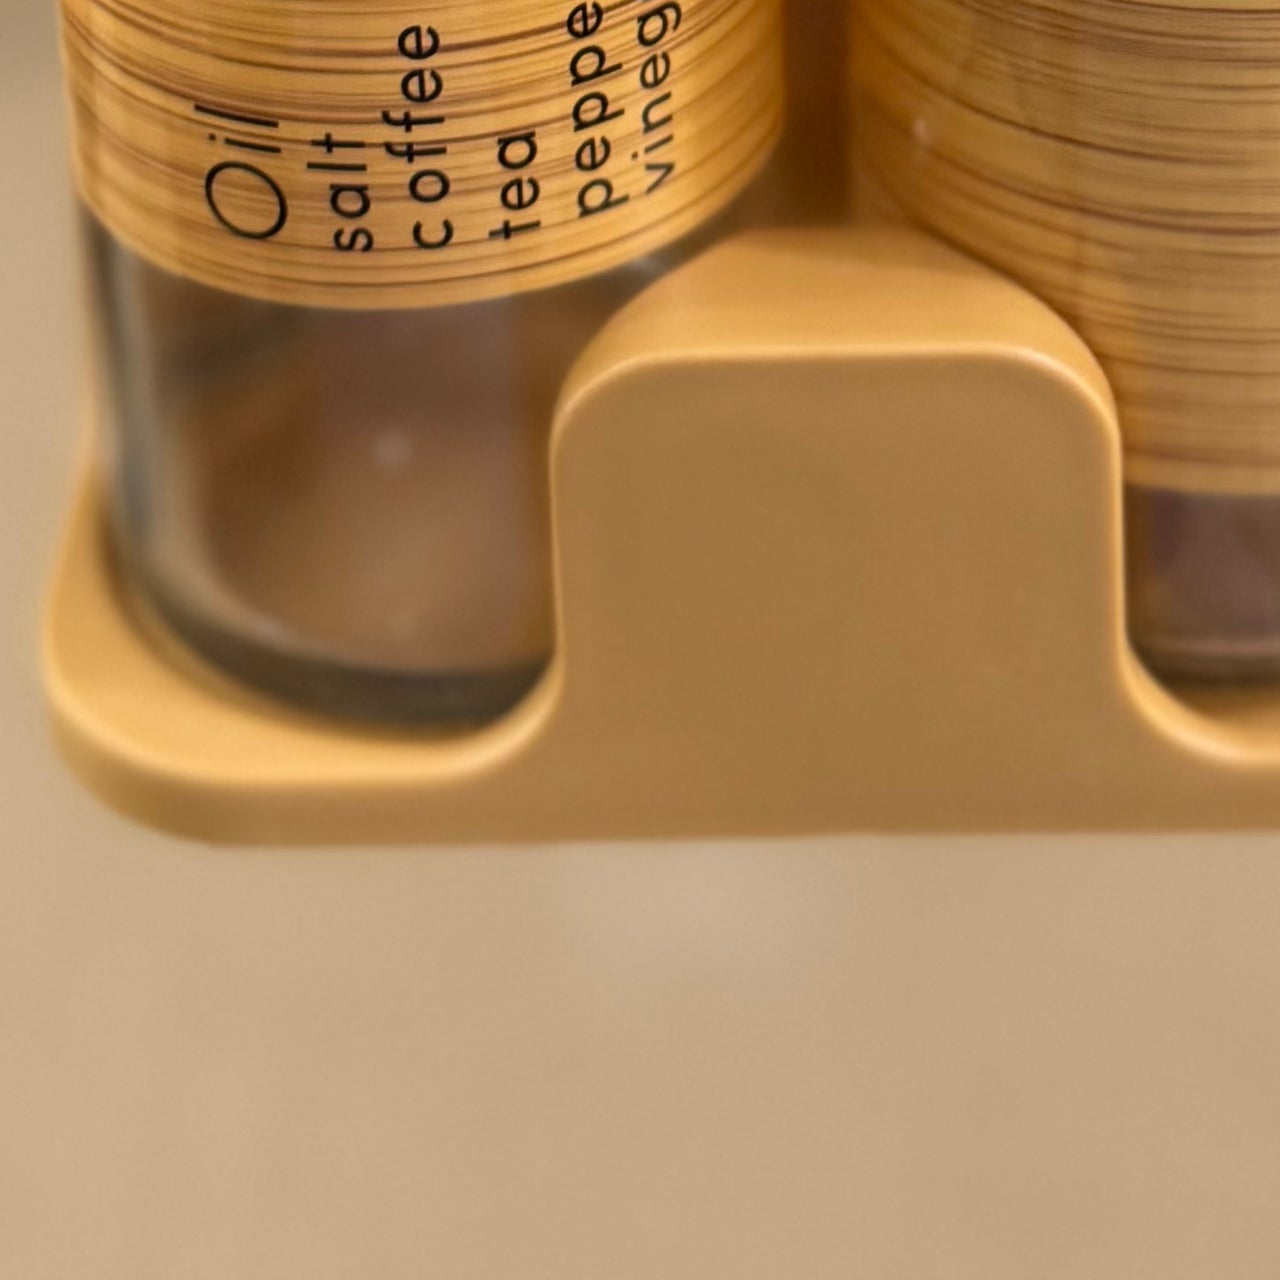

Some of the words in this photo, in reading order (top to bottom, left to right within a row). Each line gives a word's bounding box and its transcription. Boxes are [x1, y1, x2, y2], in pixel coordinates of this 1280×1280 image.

[194, 104, 287, 239] Oil
[306, 133, 373, 253] salt
[382, 24, 453, 250] coffee
[489, 131, 540, 240] tea
